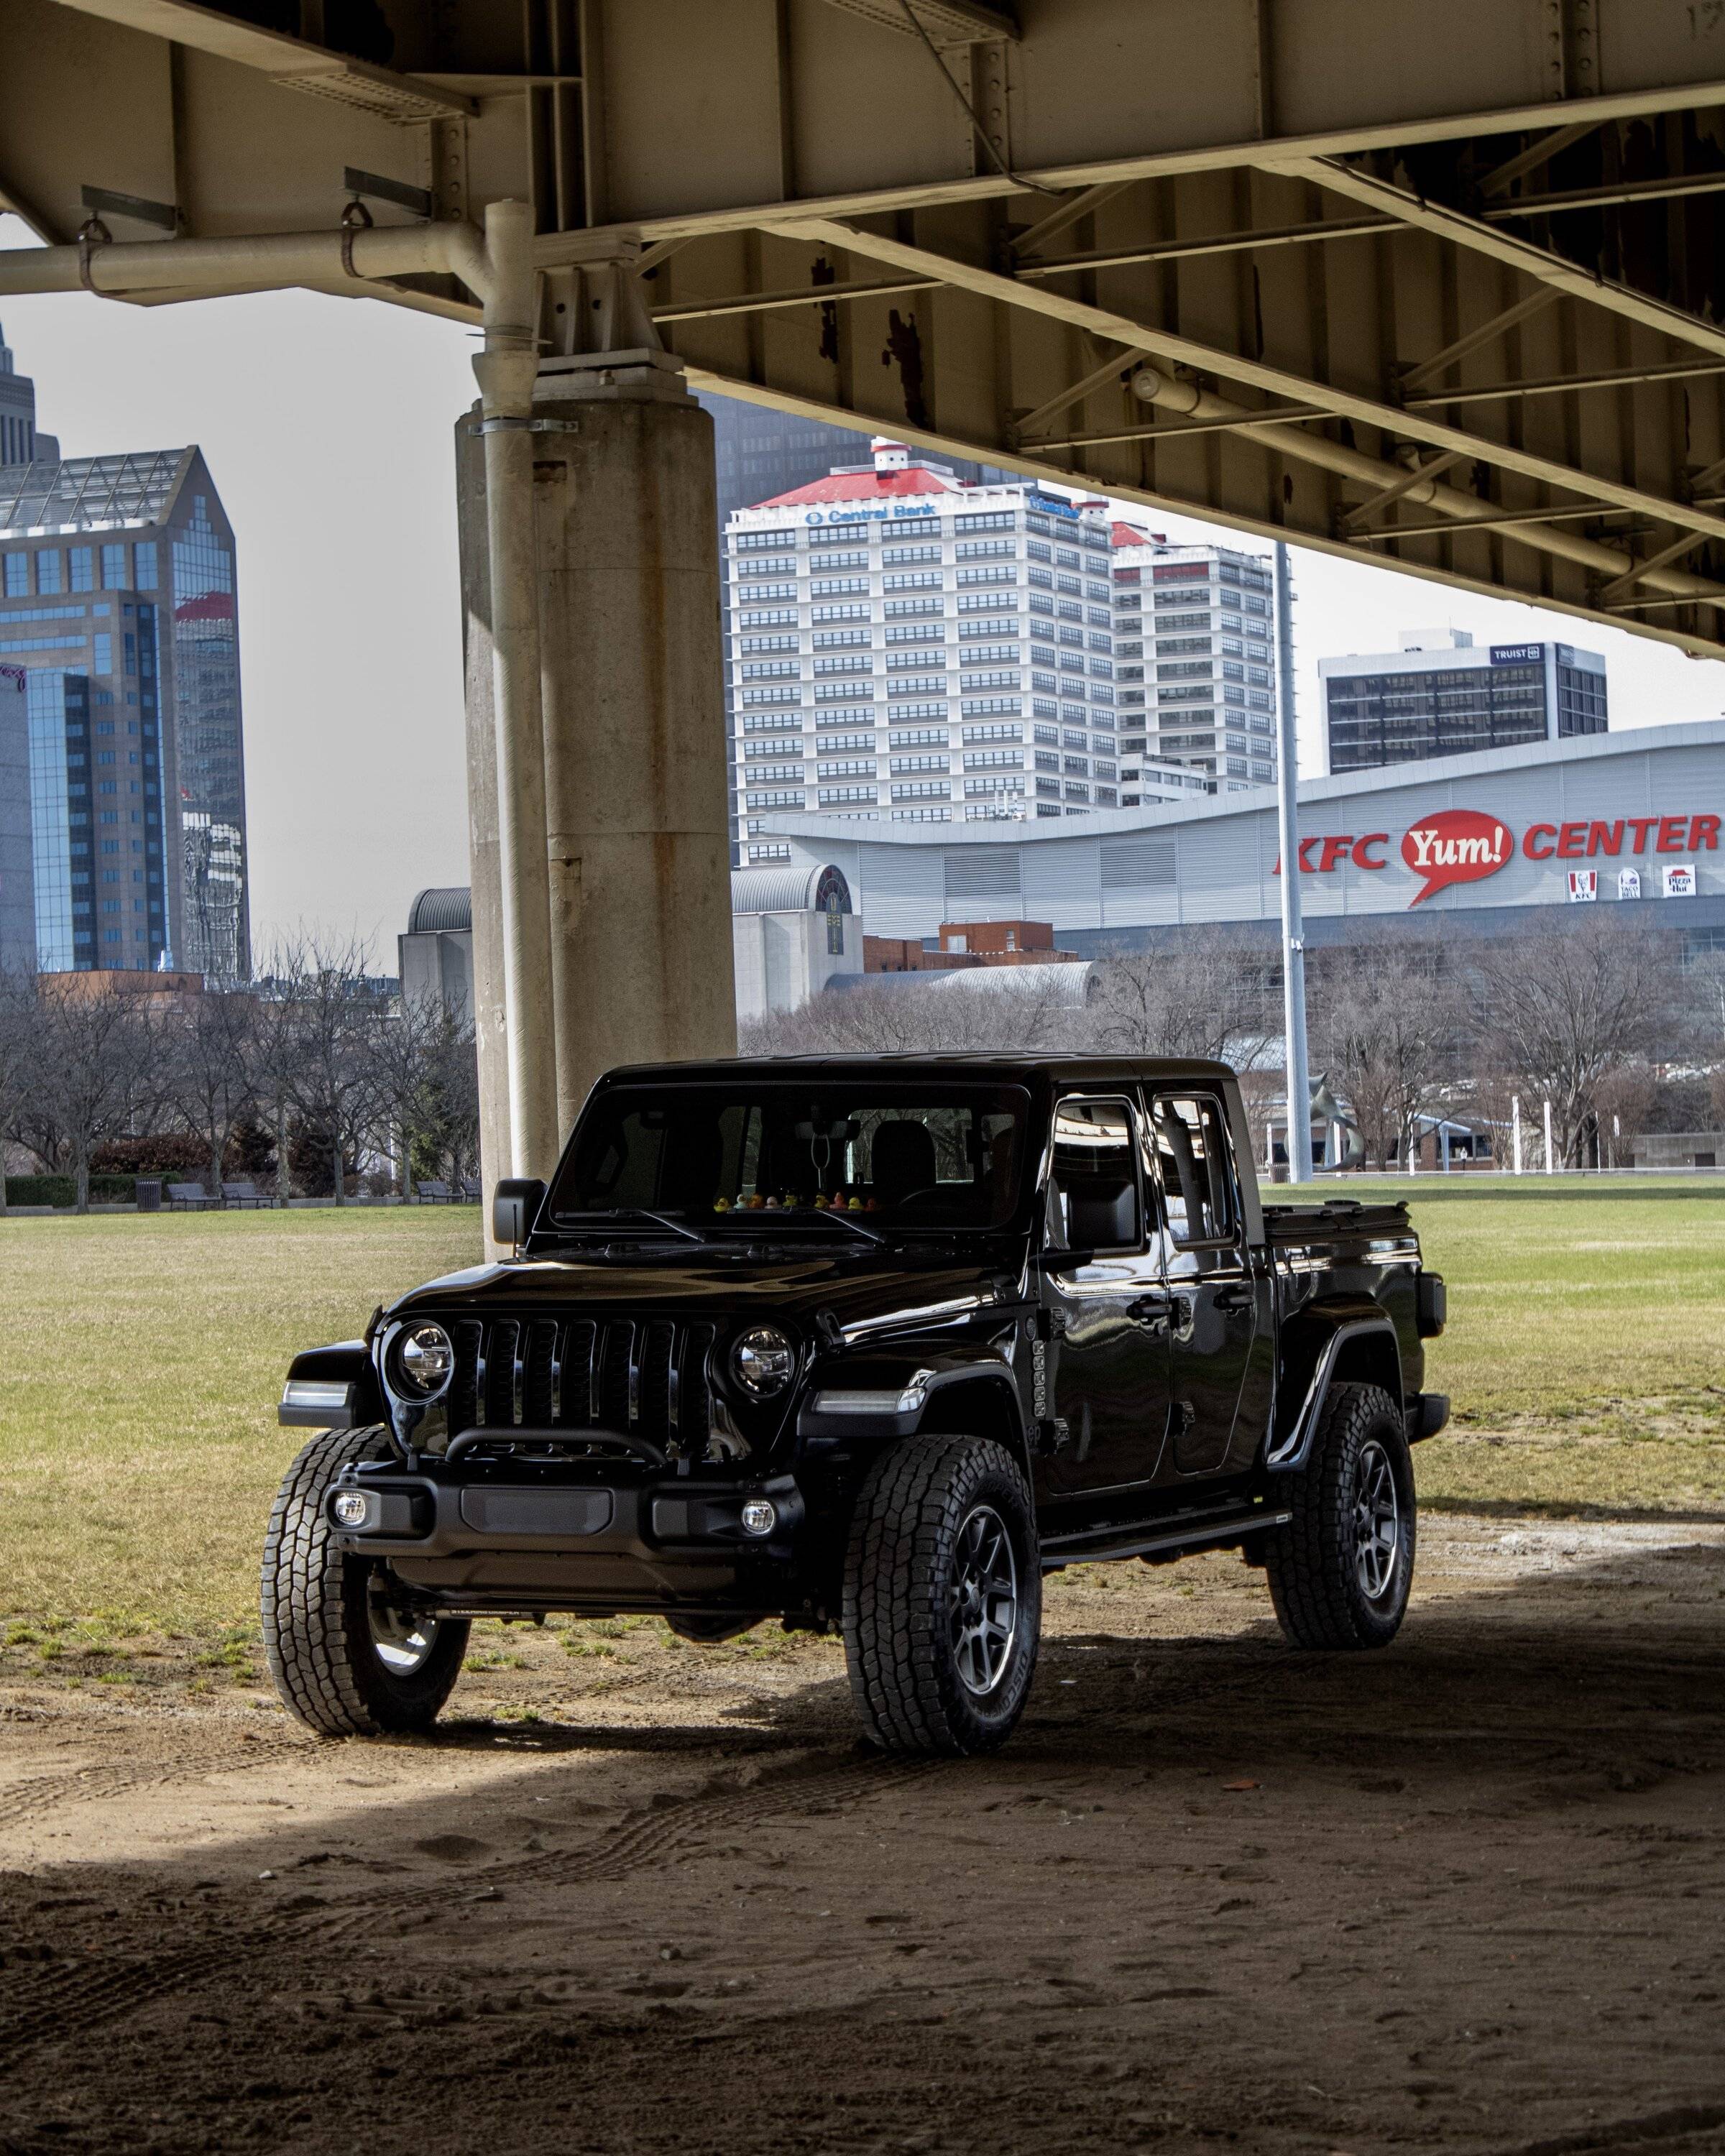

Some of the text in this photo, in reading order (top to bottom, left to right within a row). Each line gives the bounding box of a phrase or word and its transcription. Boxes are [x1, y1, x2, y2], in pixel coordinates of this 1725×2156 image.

[829, 503, 936, 523] Central Bank
[1494, 648, 1527, 659] TRUIST
[1409, 826, 1504, 867] Yum!
[1522, 814, 1721, 860] CENTER
[1668, 876, 1691, 886] Pizza
